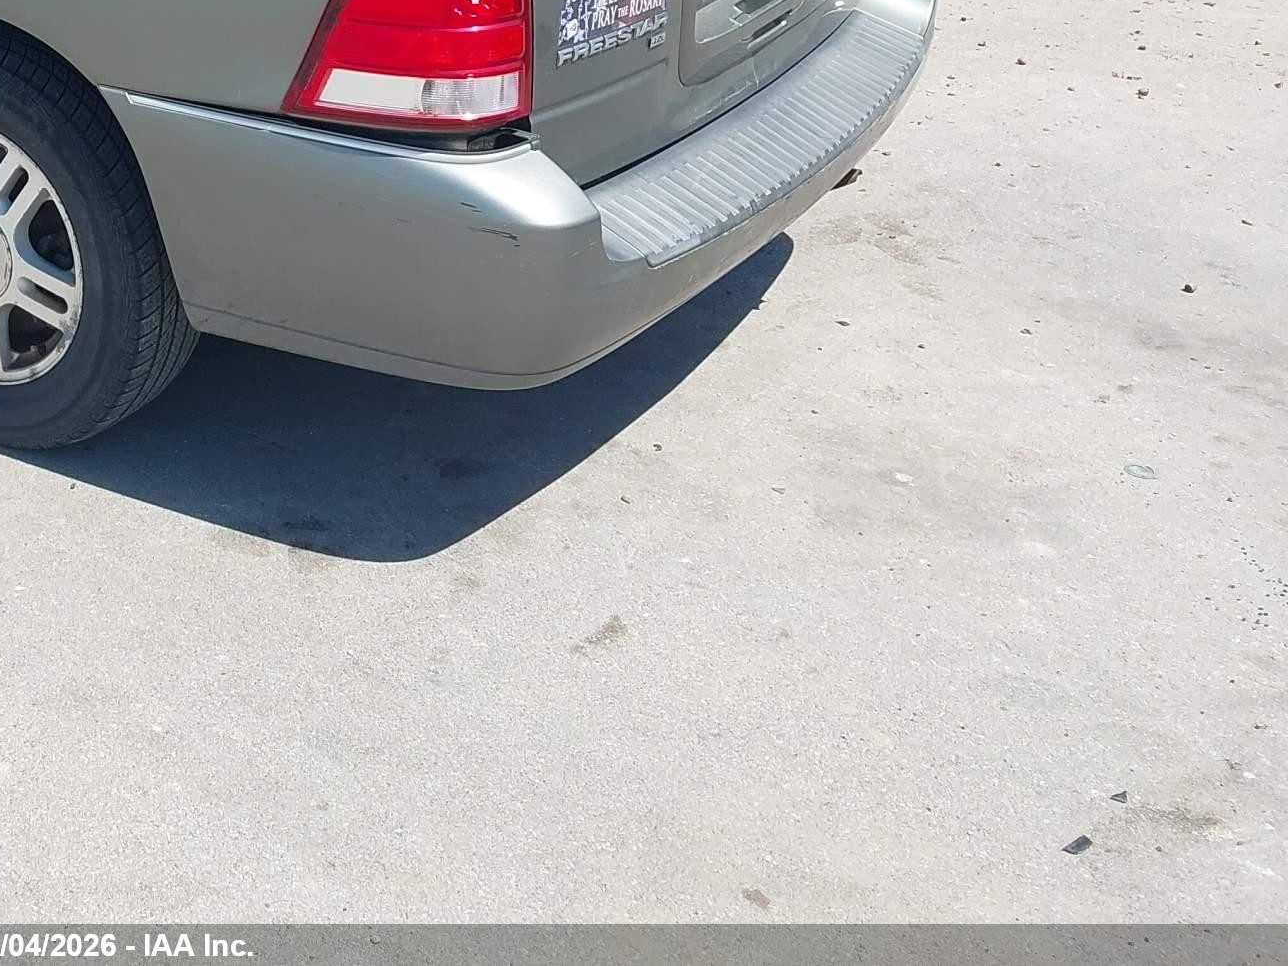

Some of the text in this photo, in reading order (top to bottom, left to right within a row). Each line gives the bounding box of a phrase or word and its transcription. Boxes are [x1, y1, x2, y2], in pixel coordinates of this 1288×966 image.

[591, 5, 618, 30] PRAY
[618, 5, 629, 18] THE
[556, 12, 668, 66] FREESTAR
